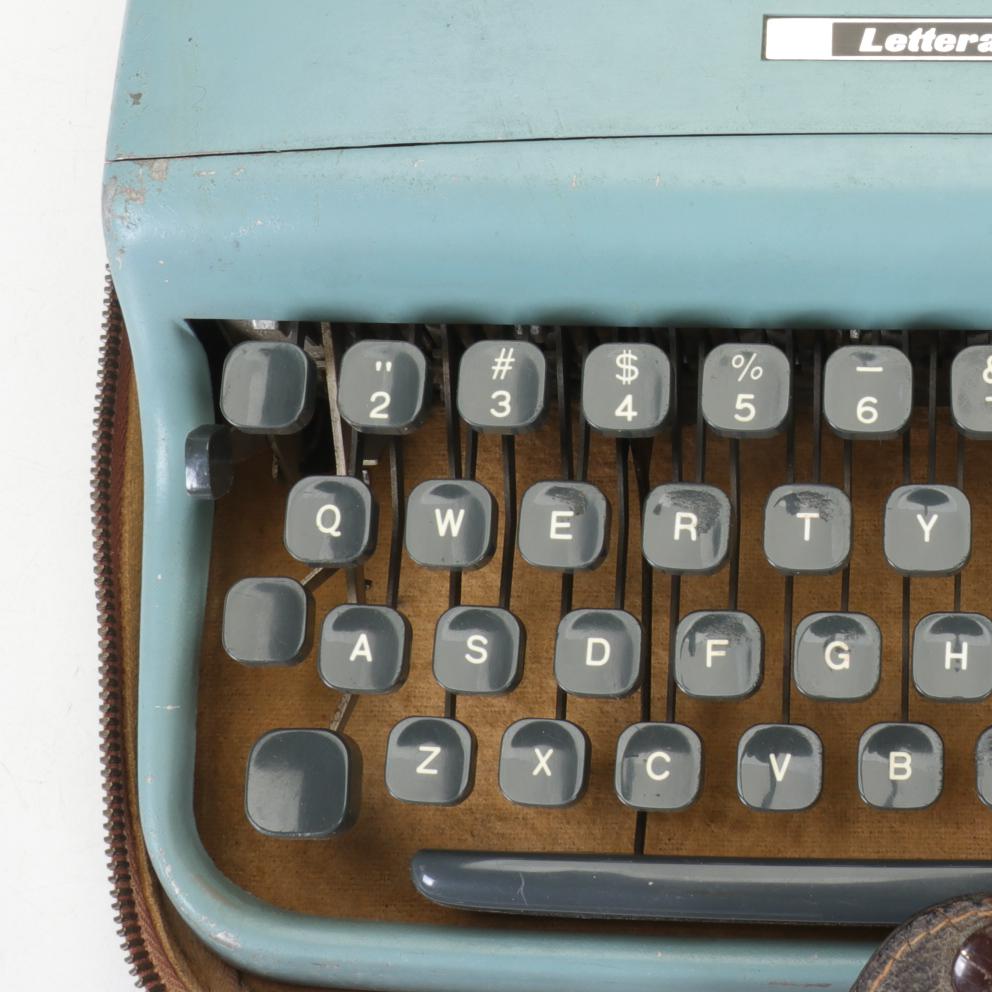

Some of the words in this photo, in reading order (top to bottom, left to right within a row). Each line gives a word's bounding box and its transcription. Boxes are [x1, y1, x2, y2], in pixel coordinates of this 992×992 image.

[490, 347, 516, 380] #
[613, 347, 641, 387] $
[731, 352, 763, 382] %
[367, 389, 393, 421] 2
[488, 388, 514, 420] 3
[612, 392, 640, 424] 4
[732, 392, 758, 424] 5
[854, 395, 881, 426] 6
[315, 504, 342, 537] Q
[434, 508, 465, 538] W
[549, 510, 574, 540] E
[673, 511, 697, 542] R
[796, 512, 819, 542] T
[916, 513, 938, 543] Y
[349, 633, 373, 663] A
[465, 635, 489, 665] S
[585, 637, 611, 667] D
[705, 639, 729, 668] F
[824, 641, 851, 670] G
[944, 641, 968, 670] H
[416, 746, 441, 775] Z
[531, 748, 553, 777] X
[645, 751, 671, 782] C
[769, 753, 792, 783] V
[888, 752, 912, 781] B
